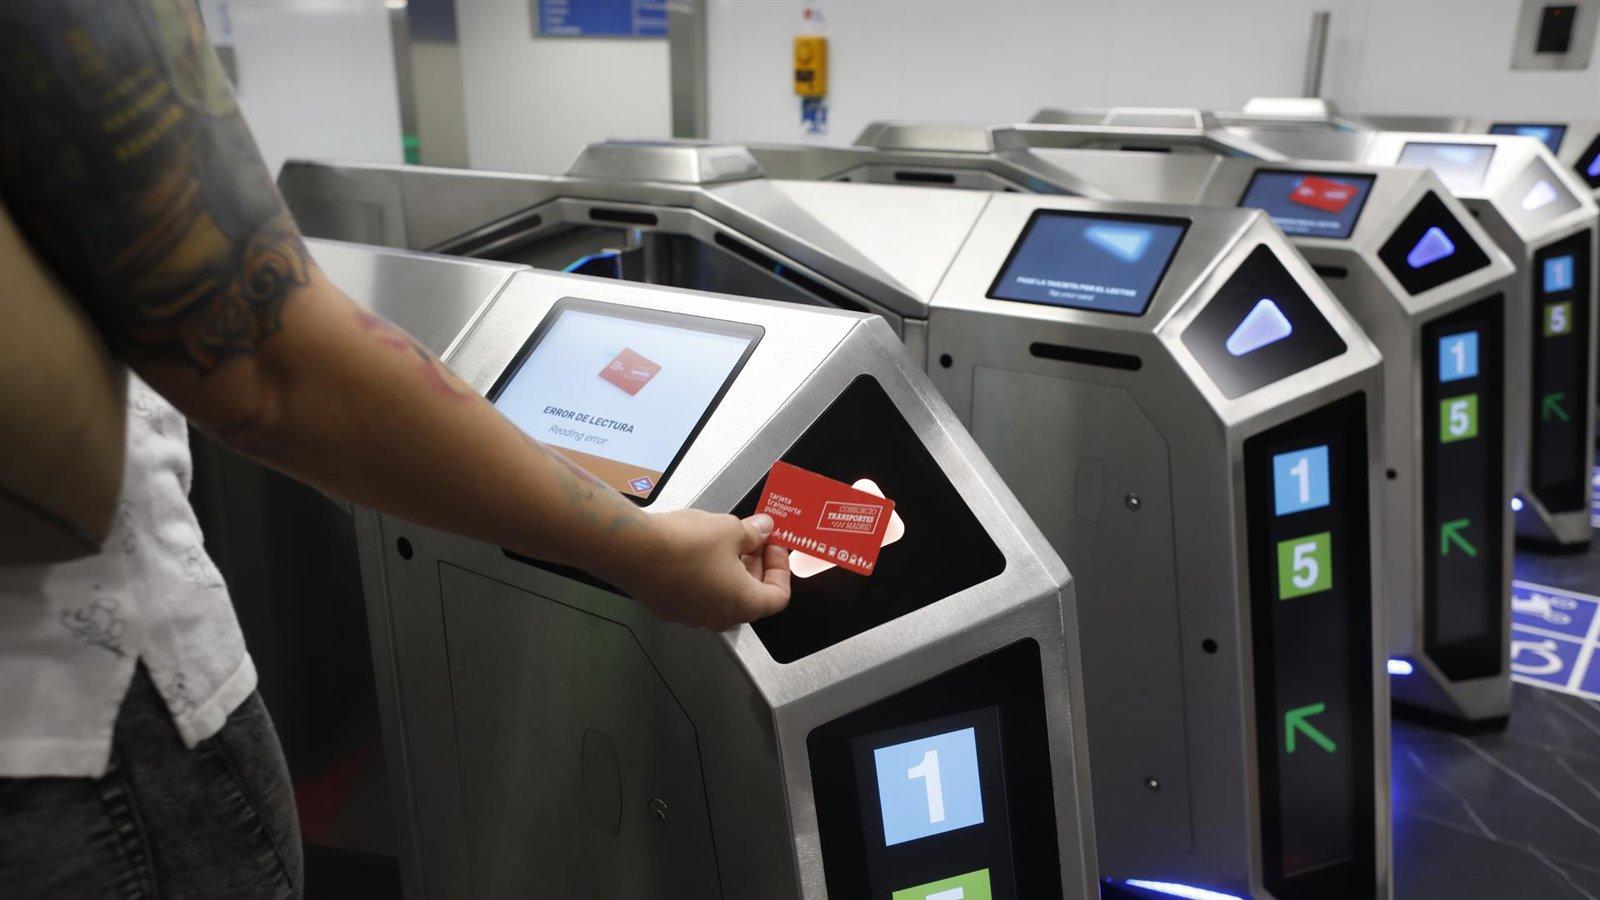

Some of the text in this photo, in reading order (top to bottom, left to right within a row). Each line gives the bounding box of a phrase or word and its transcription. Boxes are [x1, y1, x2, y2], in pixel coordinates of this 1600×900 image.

[1553, 263, 1564, 285] 1
[1551, 304, 1568, 333] 5
[1449, 340, 1465, 374] 1
[543, 405, 634, 434] ERROR DE LECTURA
[1449, 400, 1470, 437] 5
[548, 424, 608, 446] Reading error
[1290, 458, 1309, 504] 1
[767, 499, 802, 516] transporte
[770, 492, 792, 505] tarjeta
[839, 504, 878, 515] CONSORCIO
[827, 511, 875, 523] TRANSPORTES
[845, 521, 872, 531] MADRID
[1292, 542, 1319, 589] 5
[907, 749, 945, 824] 1
